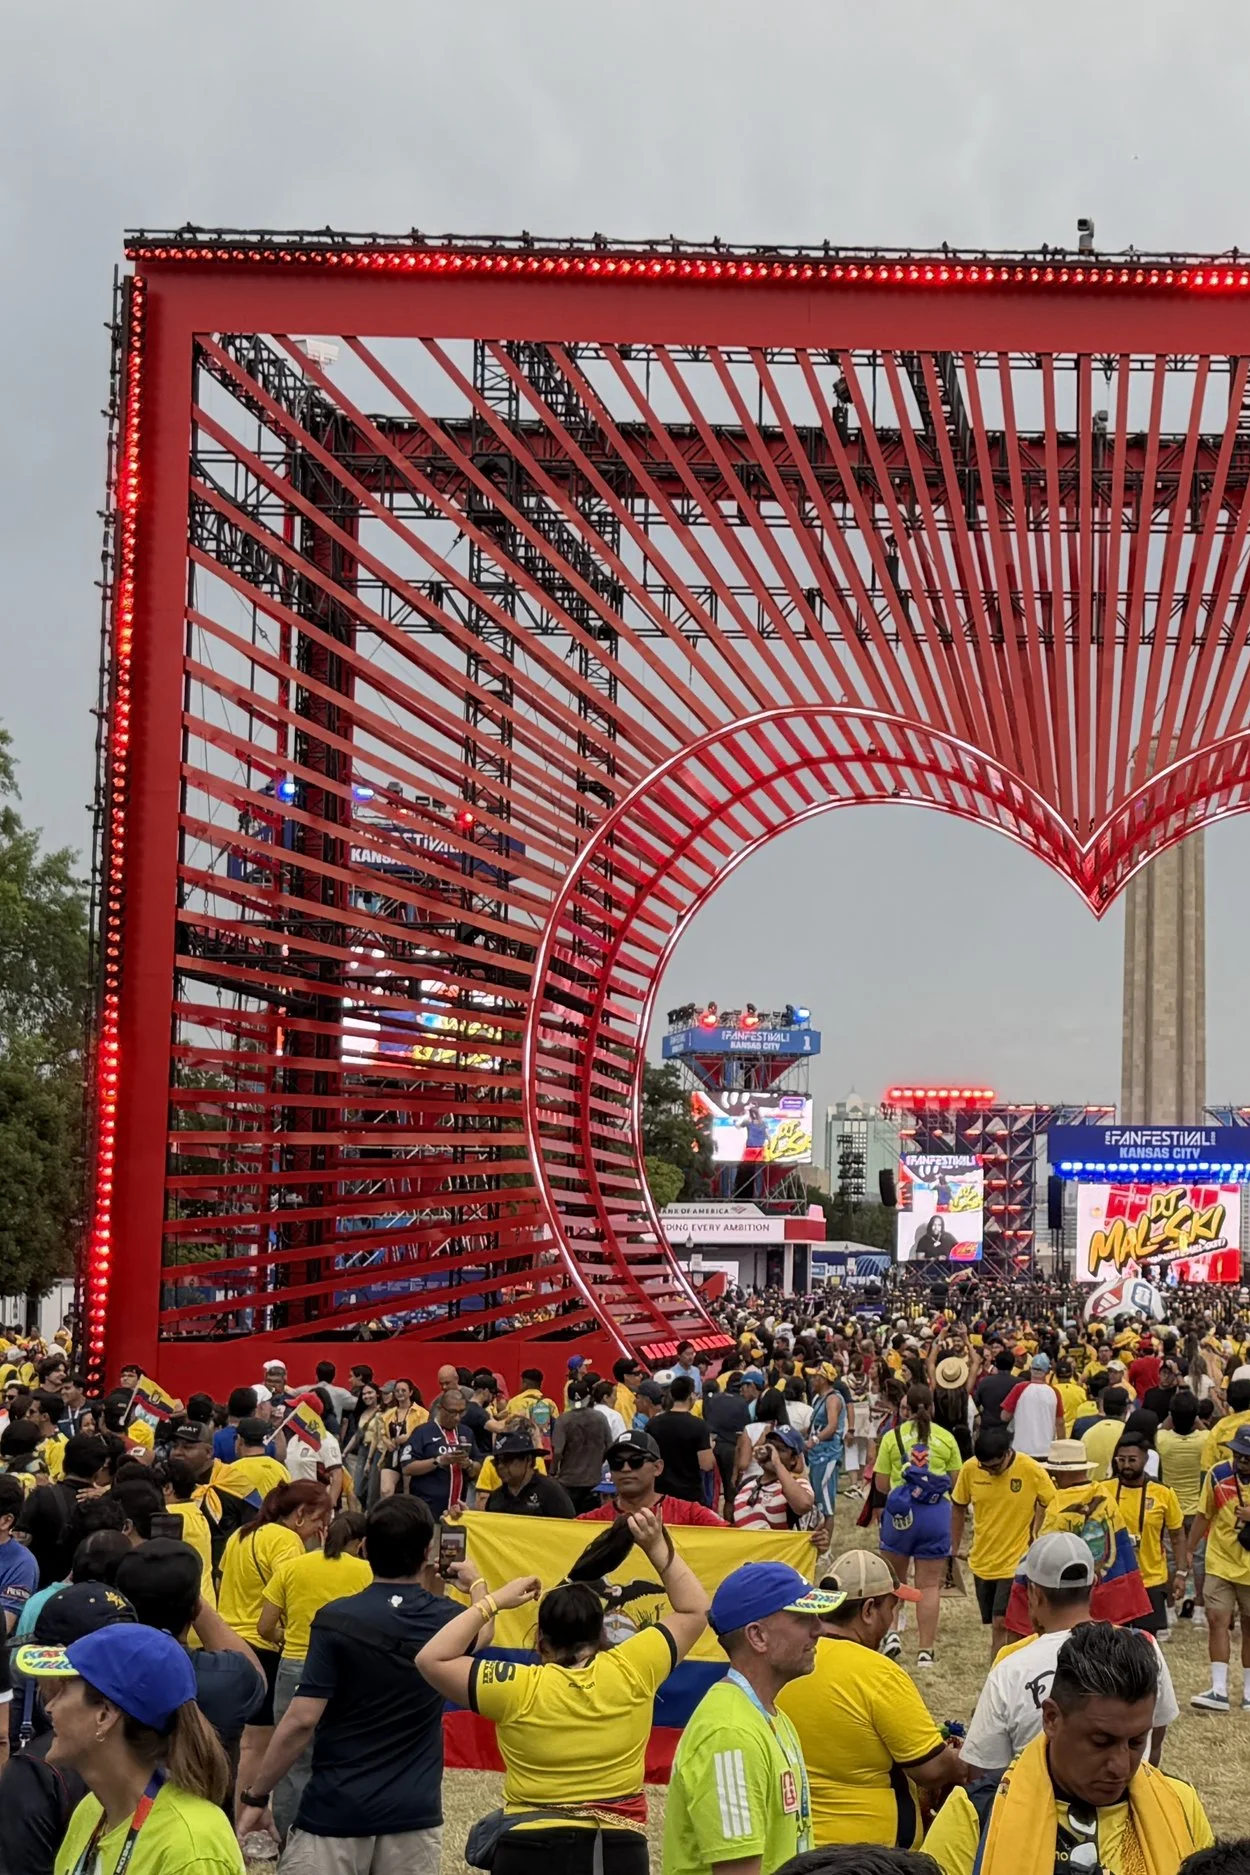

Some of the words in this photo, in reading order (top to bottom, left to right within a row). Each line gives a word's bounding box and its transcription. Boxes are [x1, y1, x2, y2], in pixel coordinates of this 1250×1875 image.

[730, 1041, 762, 1050] KANSAS
[763, 1042, 781, 1051] CITY
[803, 1036, 811, 1050] 1
[1119, 1146, 1170, 1159] KANSAS
[1172, 1147, 1201, 1159] CITY
[1150, 1187, 1187, 1221] DJ
[691, 1223, 721, 1232] EVERY
[723, 1223, 770, 1232] AMBITION
